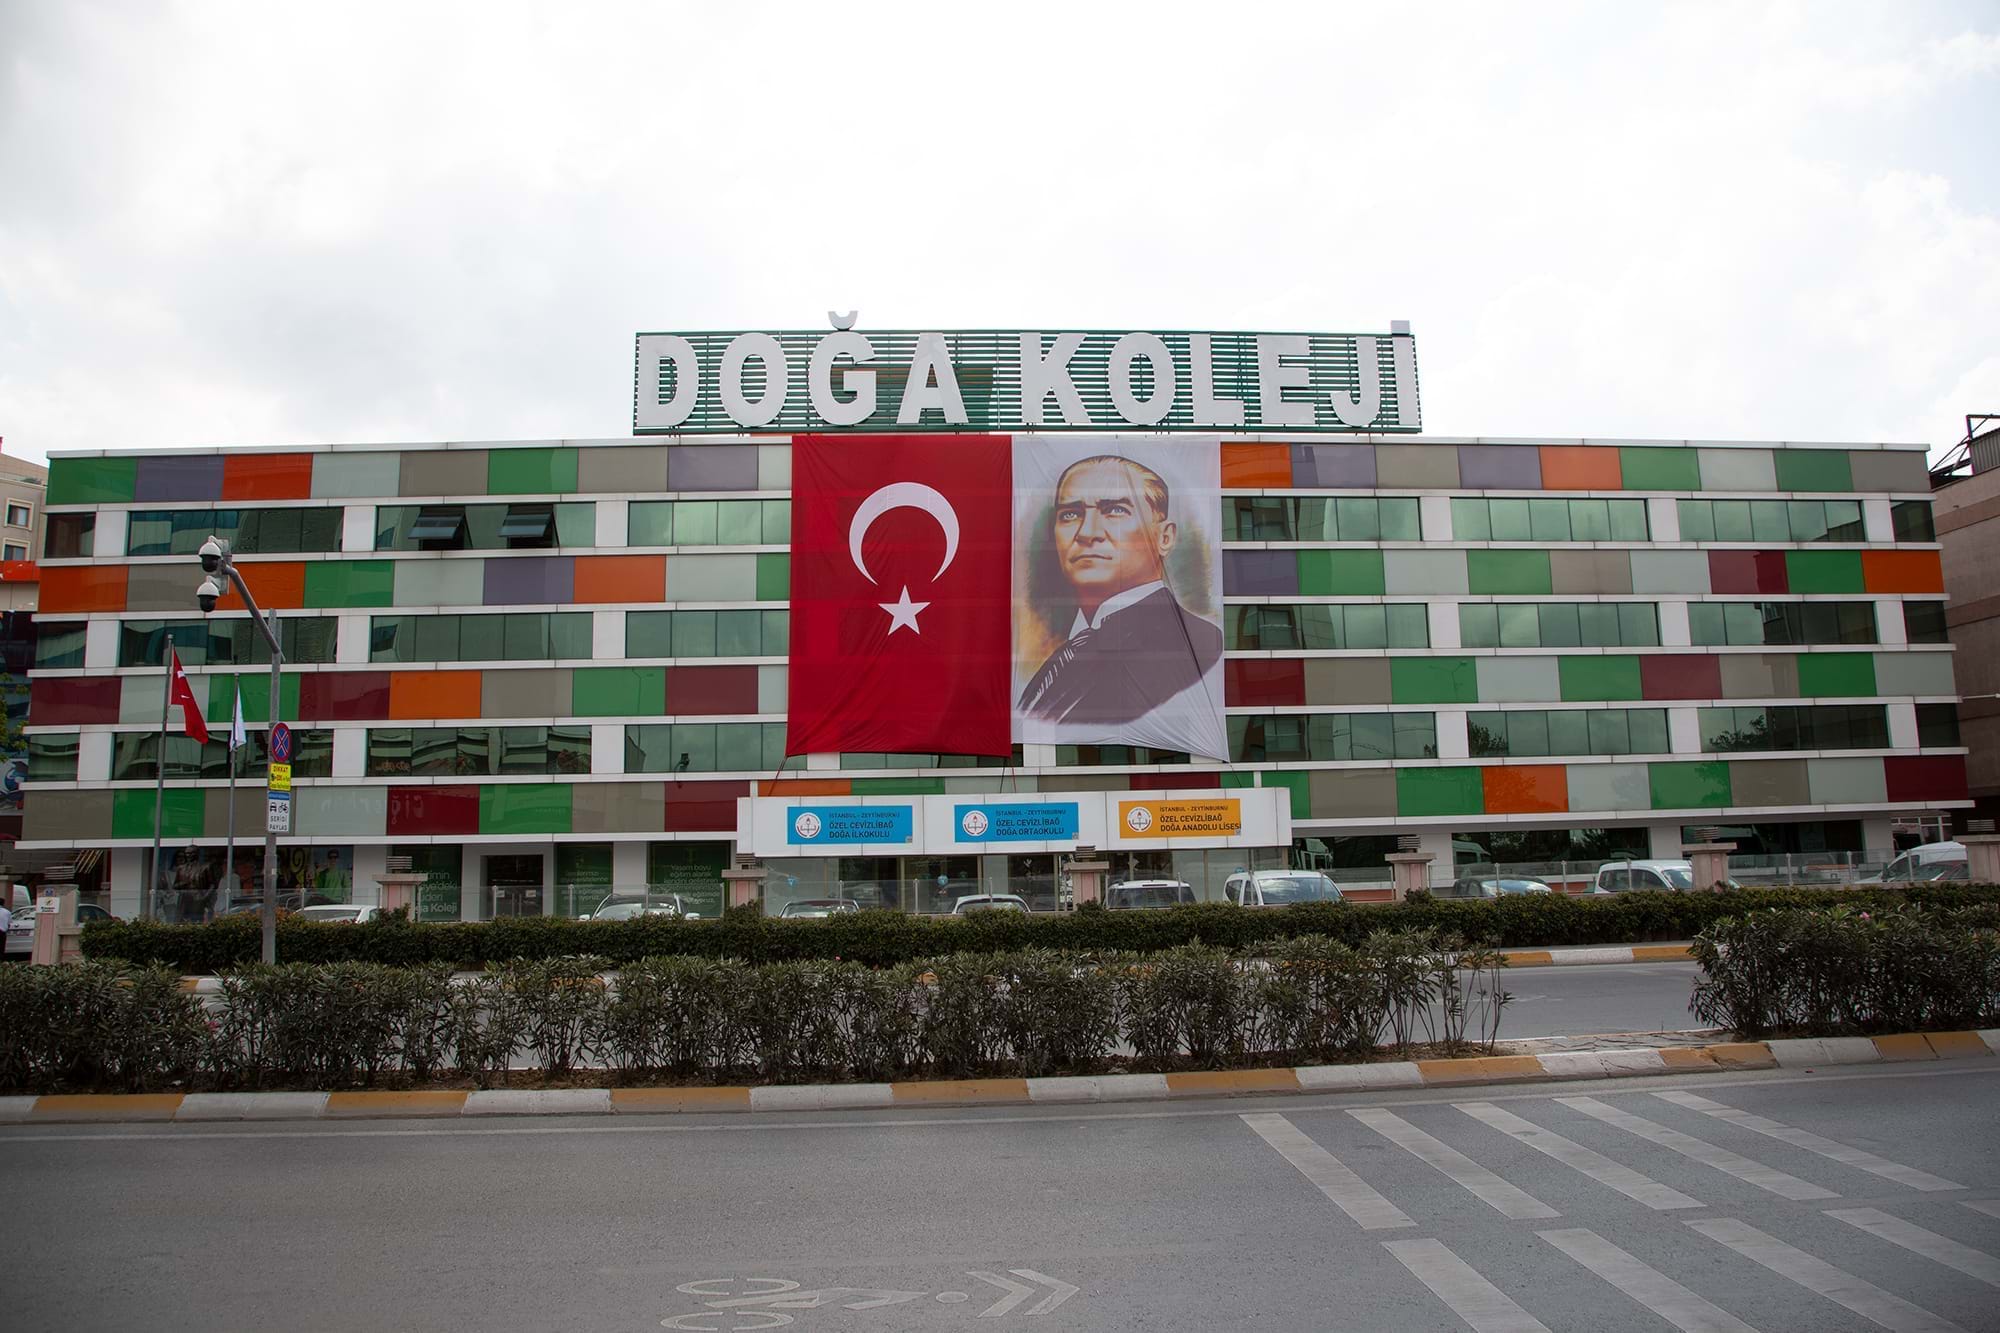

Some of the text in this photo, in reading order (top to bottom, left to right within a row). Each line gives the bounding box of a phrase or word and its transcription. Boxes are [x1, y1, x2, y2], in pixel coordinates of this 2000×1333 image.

[637, 311, 1419, 427] DOĞA KOLEJİ
[996, 817, 1060, 827] ÖZEL CEVİZLİBAĞ
[1160, 813, 1222, 823] ÖZEL CEVİZLİBAĞ
[829, 820, 894, 829] ÖZEL CEVİZLİBAĞ
[1160, 823, 1181, 832] DOĞA
[1182, 822, 1217, 831] ANADOLU
[829, 830, 890, 839] DOĞA İLKOKULU
[996, 827, 1064, 836] DOĞA ORTAOKULU
[430, 902, 457, 914] Koleji
